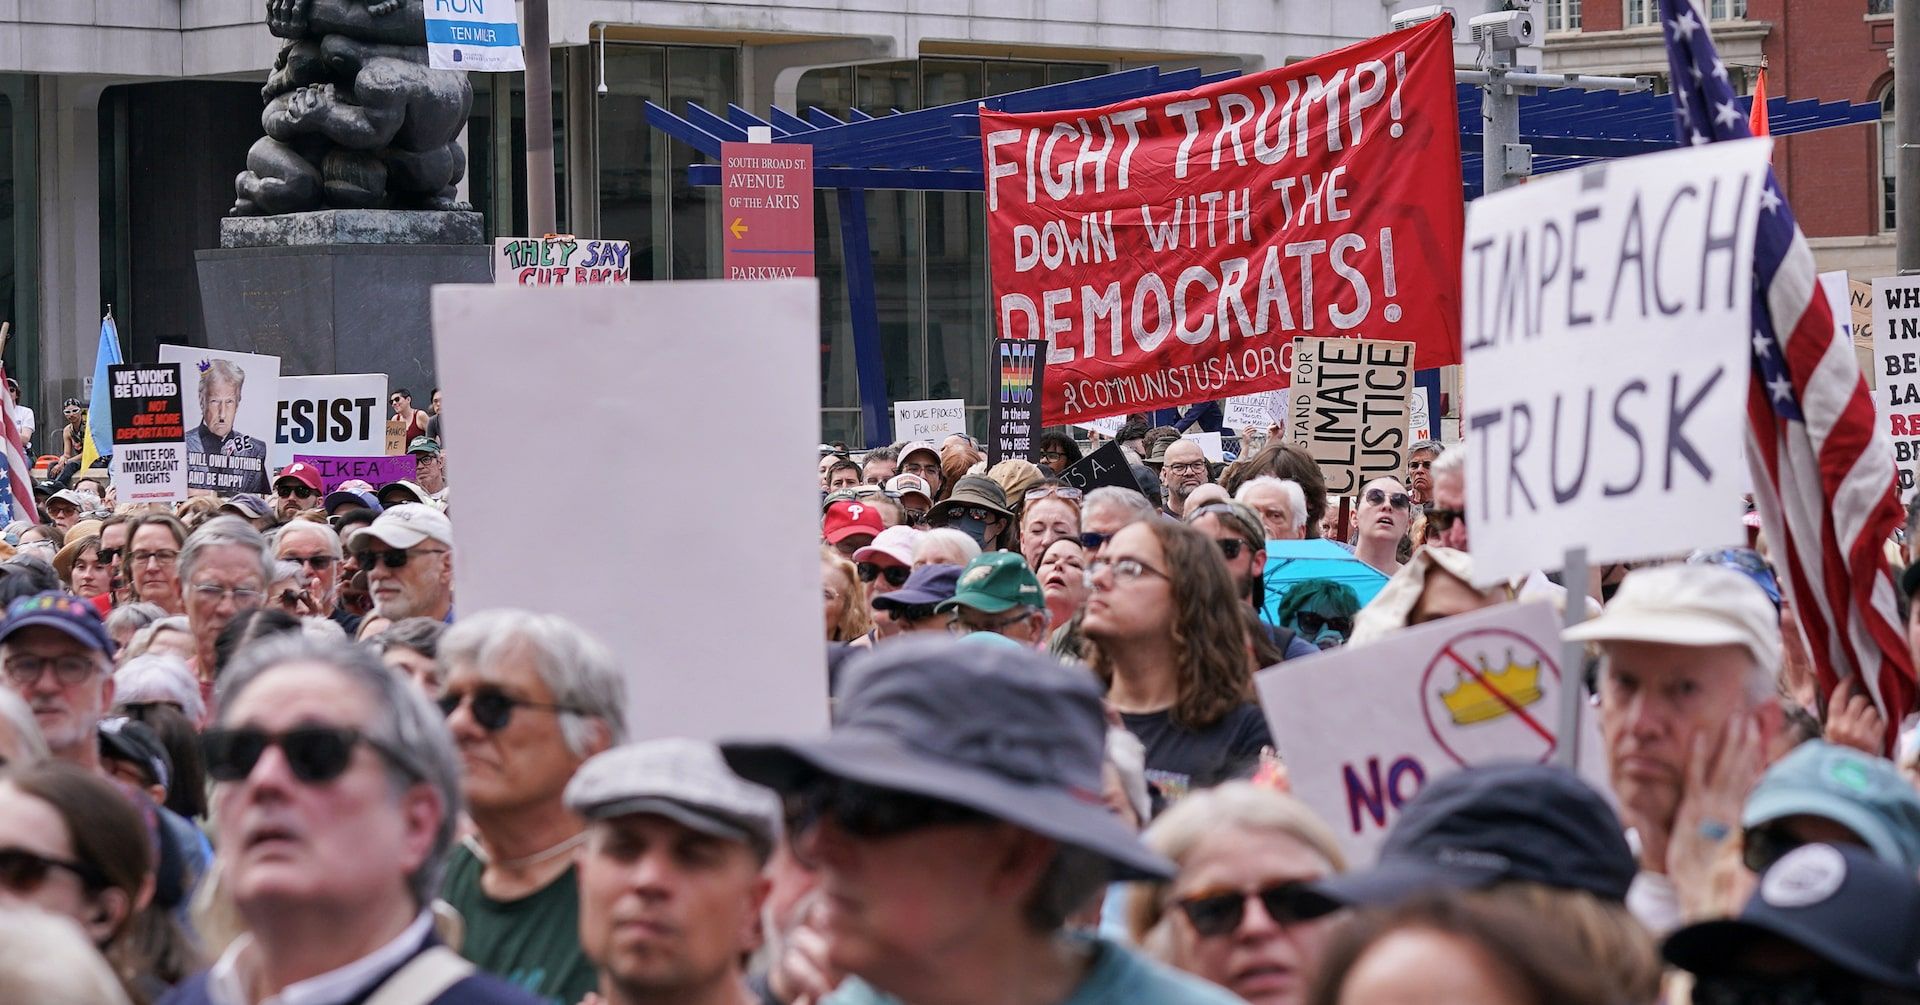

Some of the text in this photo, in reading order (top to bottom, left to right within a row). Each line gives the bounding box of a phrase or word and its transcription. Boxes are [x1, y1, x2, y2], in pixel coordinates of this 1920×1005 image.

[450, 26, 472, 40] TEN
[987, 51, 1407, 212] FIGHT TRUMP!
[728, 157, 807, 170] SOUTH BROAD ST.
[728, 174, 785, 189] AVENUE
[729, 194, 800, 209] OF THE ARTS
[1013, 165, 1351, 273] DOWN WITH THE
[504, 240, 631, 269] THEY SAY
[1467, 172, 1750, 350] IMPEACH
[730, 266, 797, 281] PARKWAY
[1000, 227, 1403, 366] DEMOCRATS!
[1297, 352, 1313, 384] FOR
[115, 369, 174, 385] WE WON'T
[114, 383, 178, 398] BE DIVIDED
[147, 400, 168, 412] NOT
[1001, 406, 1010, 420] In
[132, 413, 180, 426] ONE MORE
[1313, 341, 1363, 494] CLIMATE
[116, 426, 183, 440] DEPORTATION
[1000, 422, 1010, 434] of
[234, 435, 252, 452] BE
[1000, 437, 1013, 450] We
[1470, 365, 1725, 523] TRUSK
[125, 448, 176, 461] UNITE FOR
[122, 460, 179, 473] IMMIGRANT
[188, 453, 262, 472] WILL OWN NOTHING
[318, 460, 380, 478] IKEA
[135, 472, 171, 485] RIGHTS
[188, 471, 243, 489] AND BE HAPPY
[1343, 756, 1426, 833] NO
